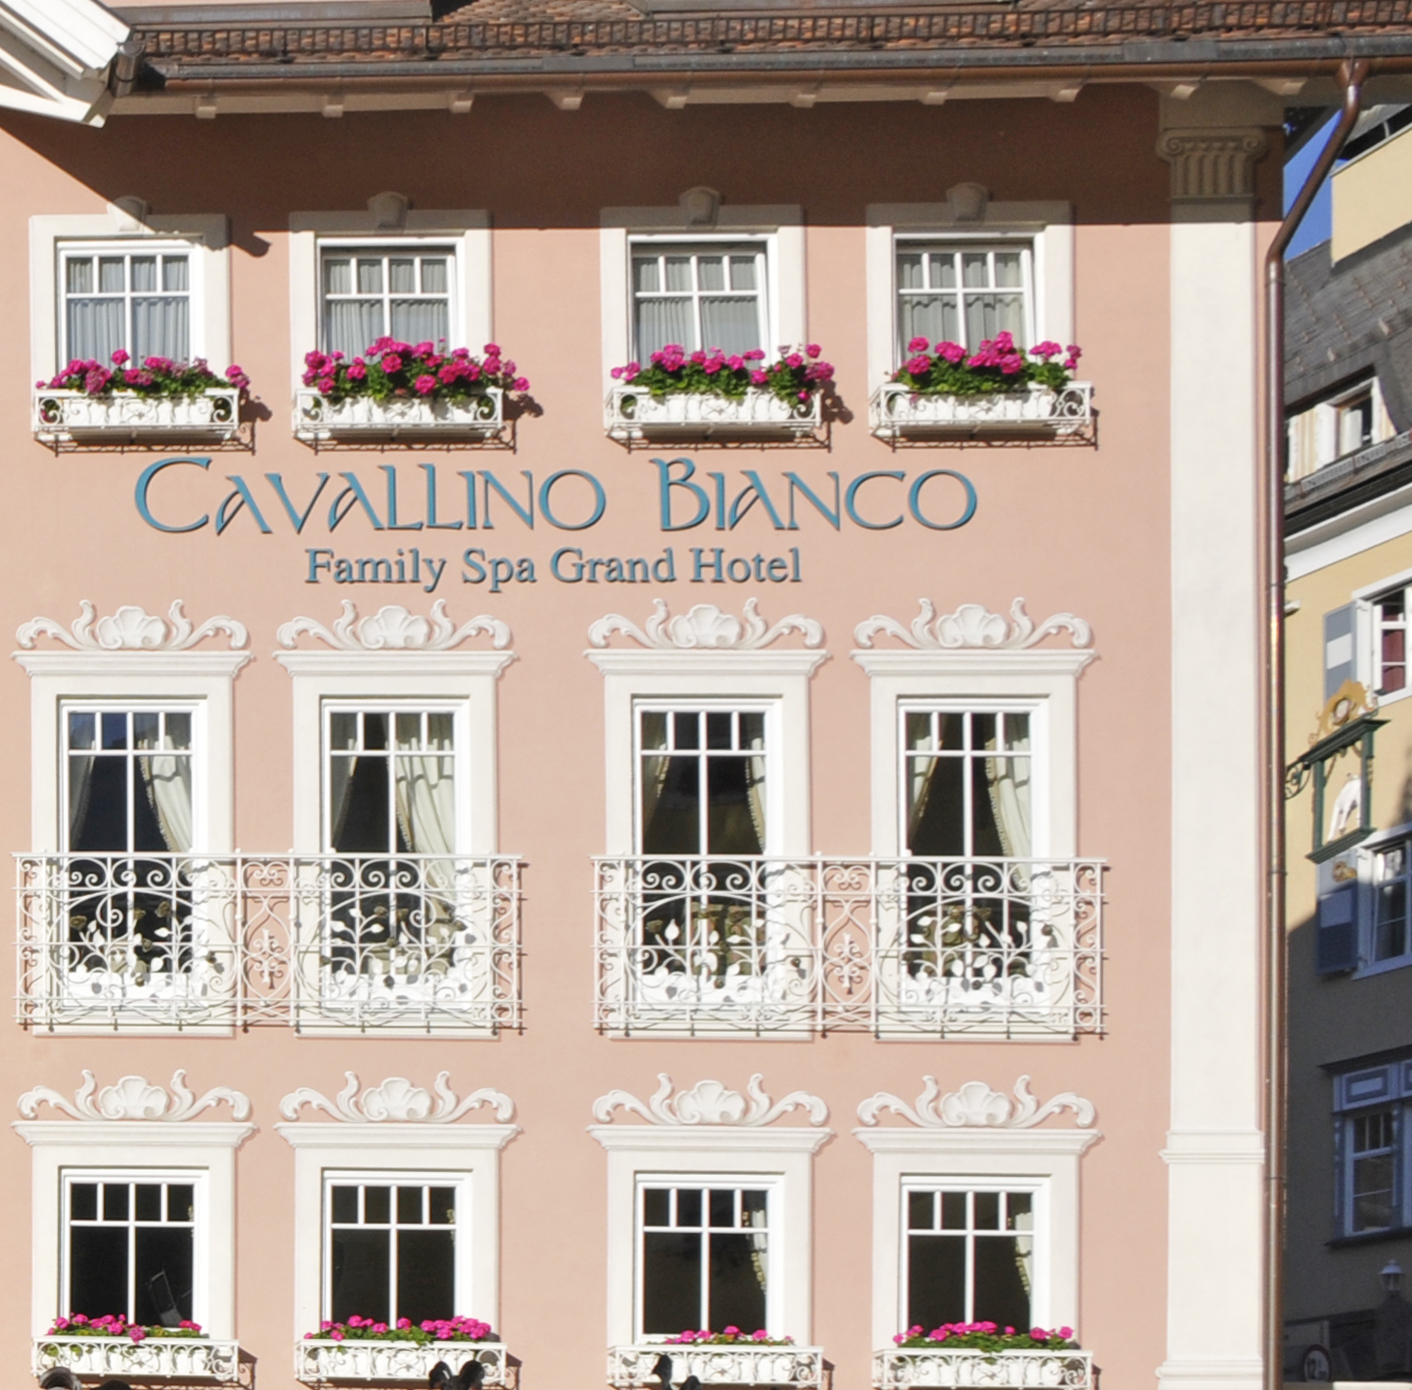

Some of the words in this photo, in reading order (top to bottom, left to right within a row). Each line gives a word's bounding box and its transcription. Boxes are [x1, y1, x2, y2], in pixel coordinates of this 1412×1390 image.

[133, 456, 607, 537] CAVALLINO
[648, 456, 979, 532] BIANCO
[304, 547, 448, 594] Family
[460, 547, 537, 594] Spa
[549, 546, 677, 584] Grand
[688, 546, 803, 584] Hotel
